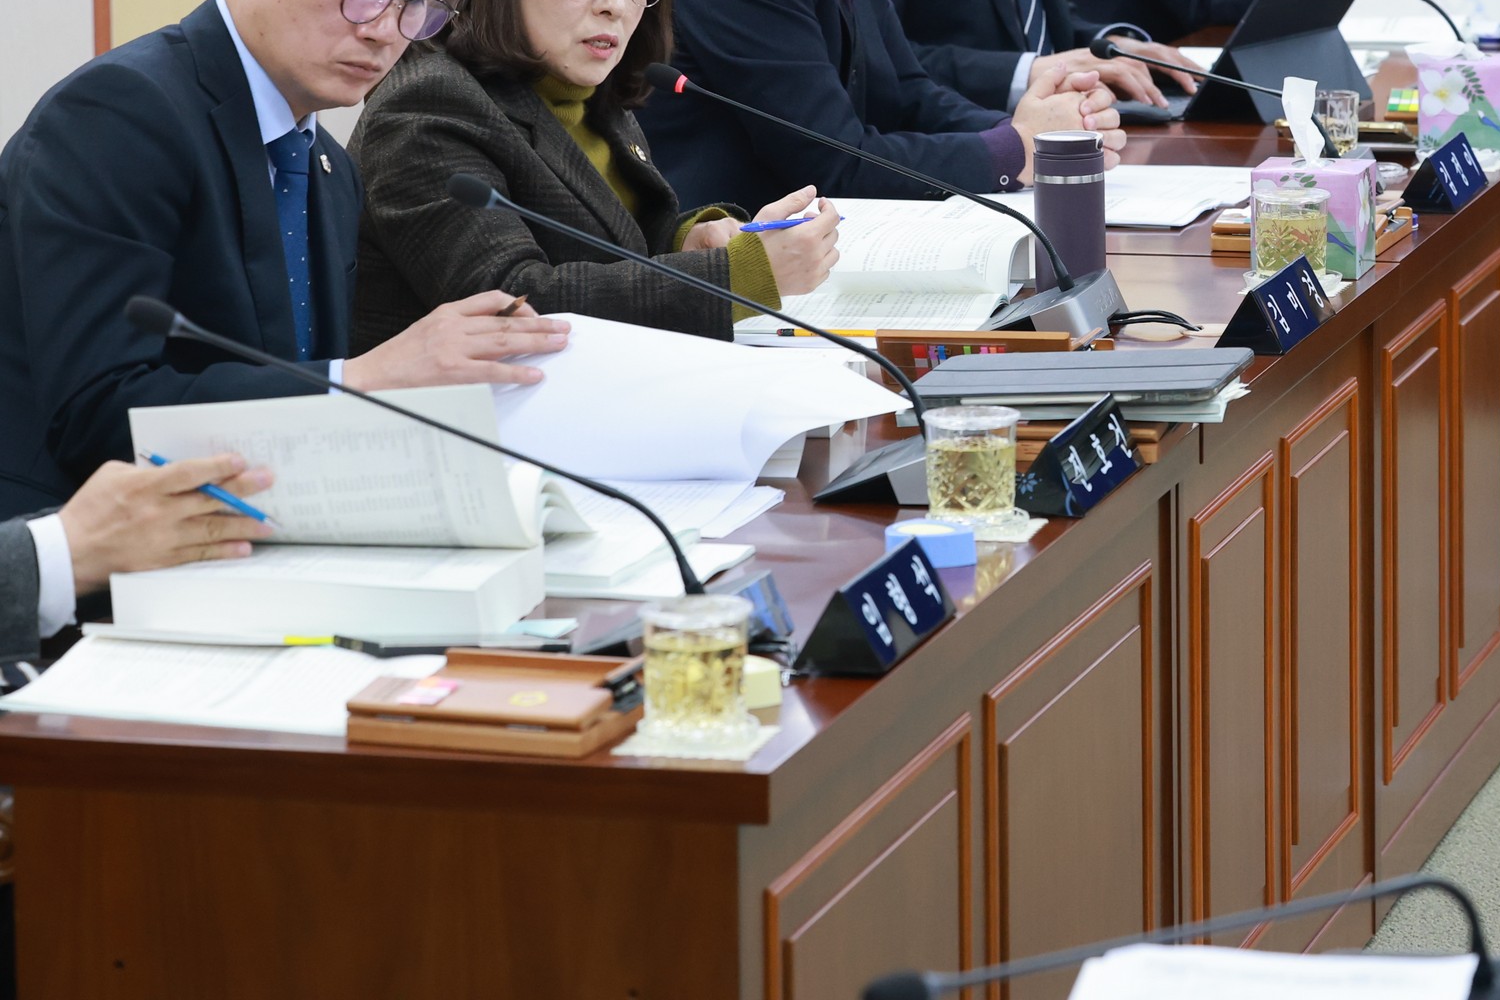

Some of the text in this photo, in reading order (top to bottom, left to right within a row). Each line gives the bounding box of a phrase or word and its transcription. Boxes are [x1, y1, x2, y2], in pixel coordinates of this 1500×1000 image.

[1266, 269, 1325, 335] 김미경
[1068, 412, 1134, 493] 진호건
[861, 554, 943, 648] 임형석
